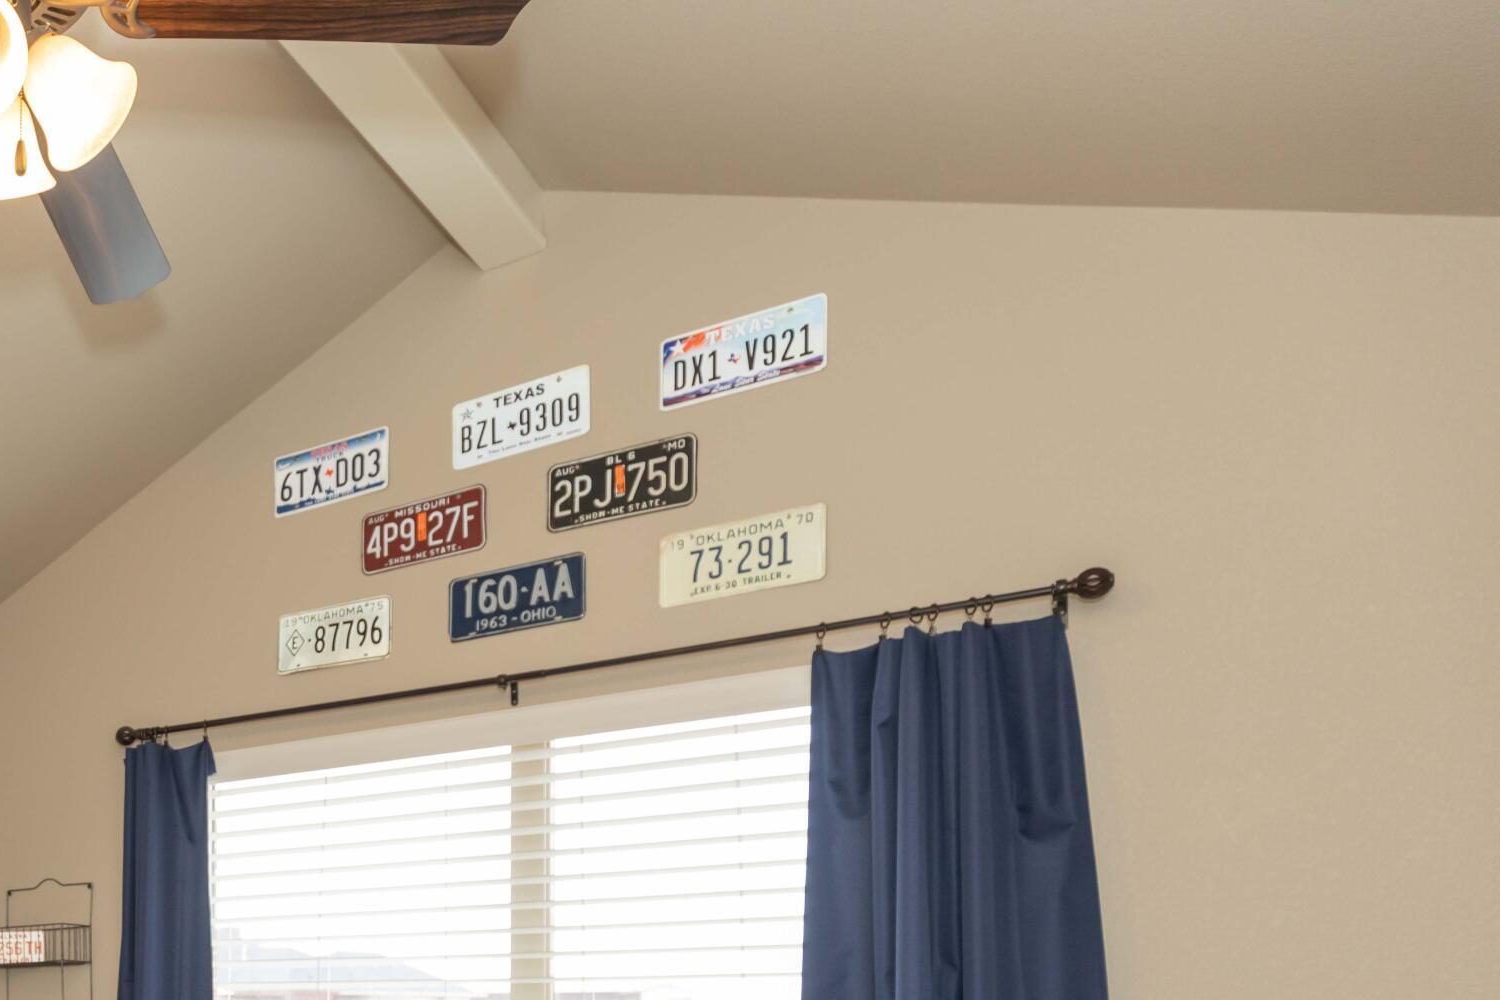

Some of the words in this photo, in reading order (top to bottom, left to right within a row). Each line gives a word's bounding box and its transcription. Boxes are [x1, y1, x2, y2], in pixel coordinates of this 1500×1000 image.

[706, 314, 775, 346] TEXAS
[674, 350, 721, 391] DX1
[746, 324, 814, 371] V921
[493, 383, 545, 408] TEXAS
[461, 417, 503, 454] BZL
[520, 393, 580, 436] 9309
[555, 466, 575, 478] AUG
[668, 438, 686, 451] MO
[280, 464, 322, 502] 6TX
[368, 514, 385, 525] AUG
[394, 497, 450, 518] MISSOURI
[579, 505, 625, 523] SHOW-ME
[627, 499, 661, 512] STATE
[696, 518, 784, 546] OKLAHOMA
[796, 511, 814, 525] 70
[388, 550, 427, 565] SHOW-ME
[429, 543, 457, 557] STATE
[742, 571, 782, 585] TRAILER
[303, 605, 364, 624] OKLAHOMA
[476, 614, 508, 631] 1963
[520, 605, 557, 623] OHIO
[314, 615, 382, 653] 87796
